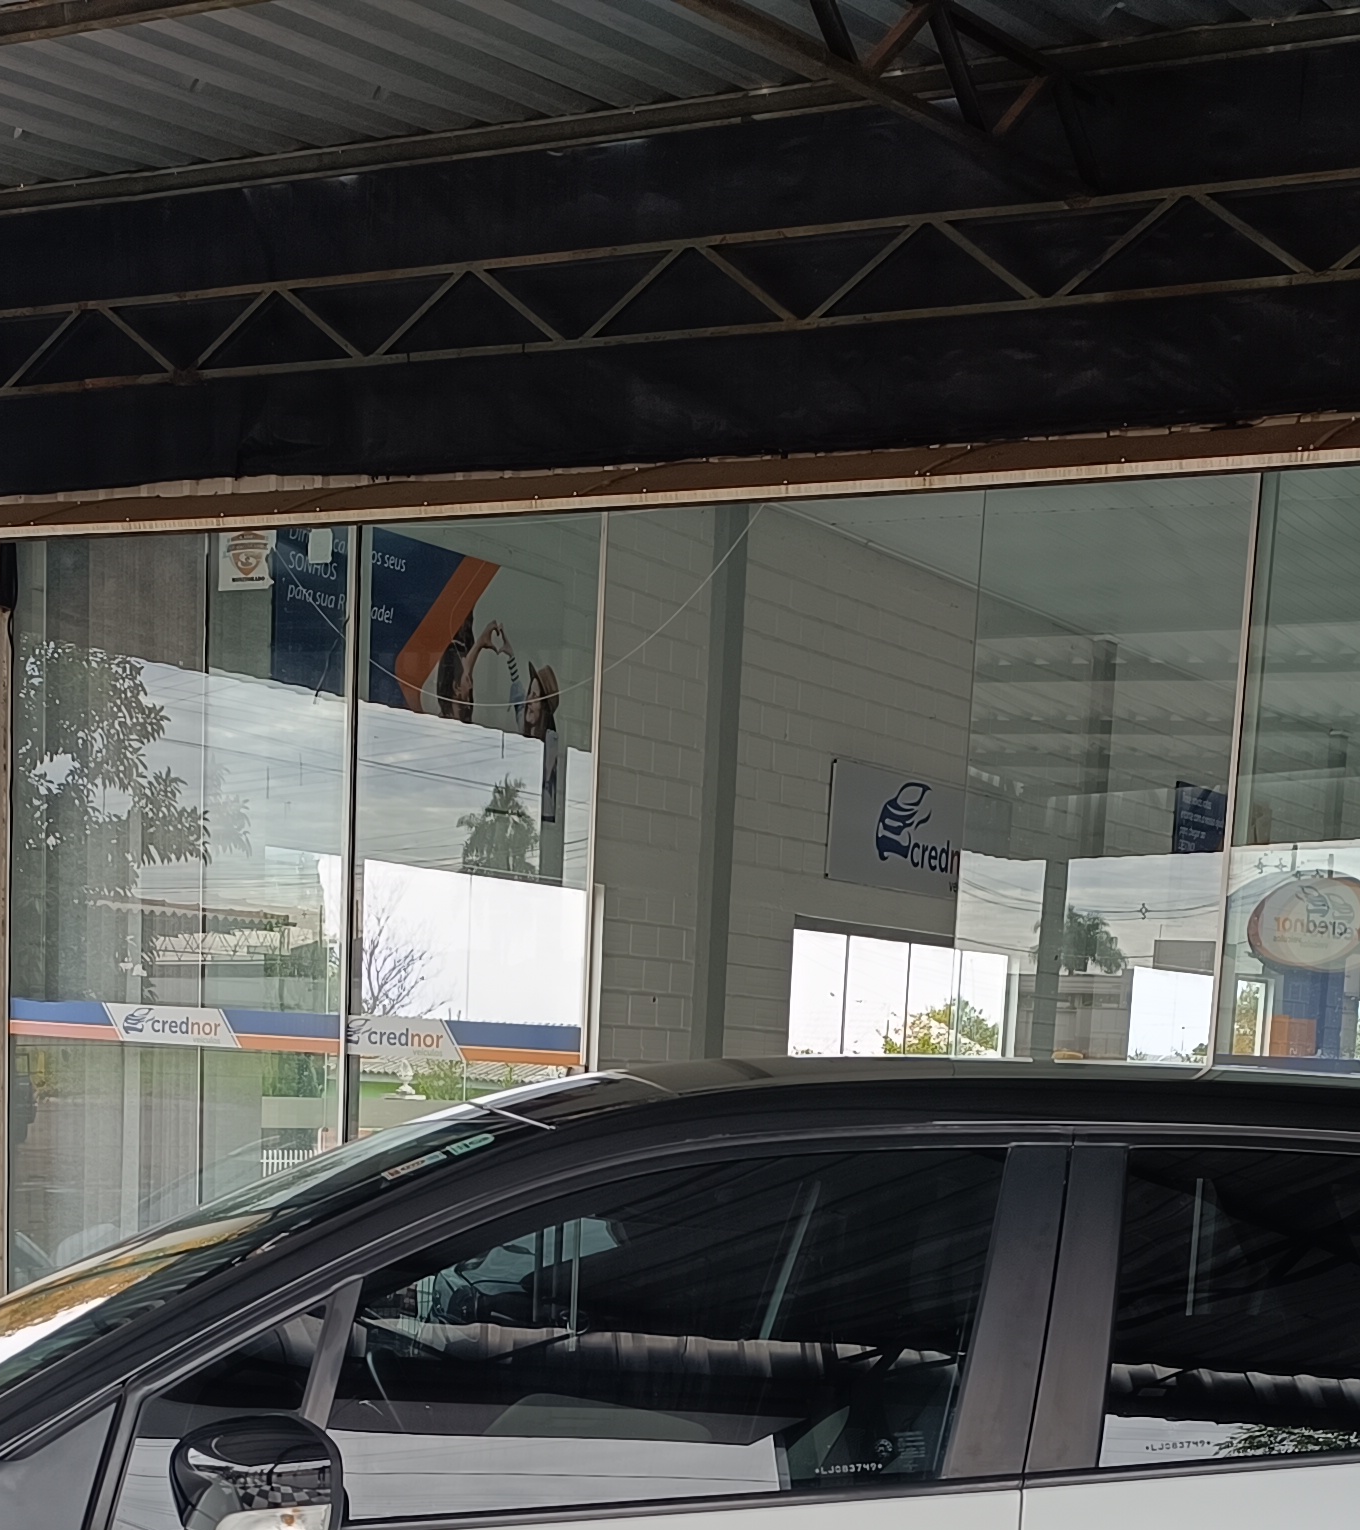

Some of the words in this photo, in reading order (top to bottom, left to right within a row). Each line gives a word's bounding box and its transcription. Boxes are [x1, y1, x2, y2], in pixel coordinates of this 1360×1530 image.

[384, 555, 407, 572] seus
[287, 584, 314, 602] para
[316, 592, 335, 609] sua
[910, 840, 960, 875] credn
[151, 1016, 220, 1036] crednor
[368, 1028, 443, 1048] crednor
